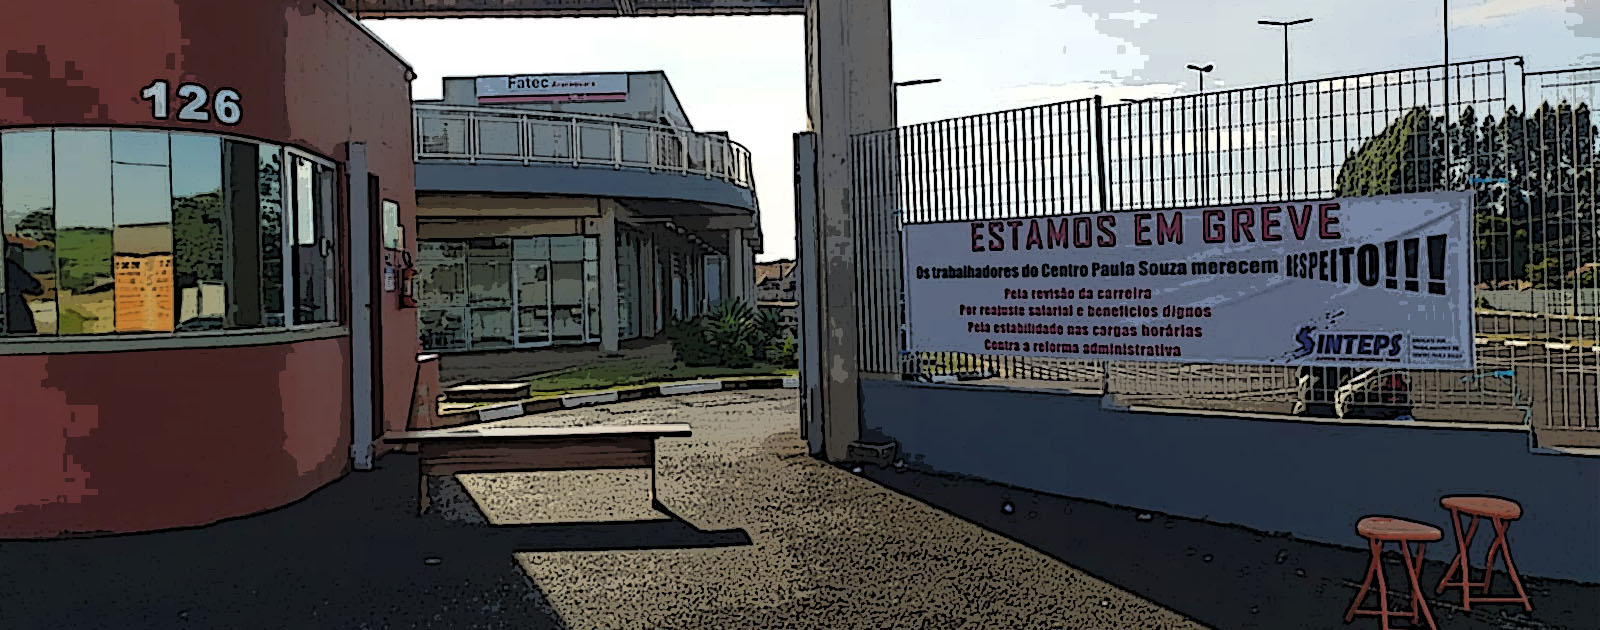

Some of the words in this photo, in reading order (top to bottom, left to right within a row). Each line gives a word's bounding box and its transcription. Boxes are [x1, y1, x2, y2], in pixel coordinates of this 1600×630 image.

[508, 76, 550, 89] Fatec
[142, 81, 242, 124] 126
[971, 215, 1117, 252] ESTAMOS
[1134, 211, 1184, 246] EM
[1202, 202, 1342, 243] GREVE
[916, 265, 930, 279] Os
[932, 264, 1020, 279] trabalhadores
[1021, 264, 1039, 278] do
[1041, 263, 1089, 278] Centro
[1091, 261, 1135, 277] Paula
[1138, 260, 1188, 277] Souza
[1191, 259, 1279, 275] merecem
[1004, 288, 1029, 300] Pela
[1078, 287, 1094, 300] da
[959, 304, 977, 316] Por
[1028, 304, 1073, 317] salarial
[1076, 306, 1084, 317] e
[1162, 304, 1212, 319] dignos
[967, 322, 991, 334] Pela
[1067, 325, 1089, 336] nas
[1092, 324, 1138, 338] cargas
[1141, 323, 1203, 338] horárias
[984, 338, 1020, 352] Contra
[1022, 341, 1031, 352] a
[1082, 342, 1182, 357] administrativa
[1294, 326, 1402, 358] SINTEPS
